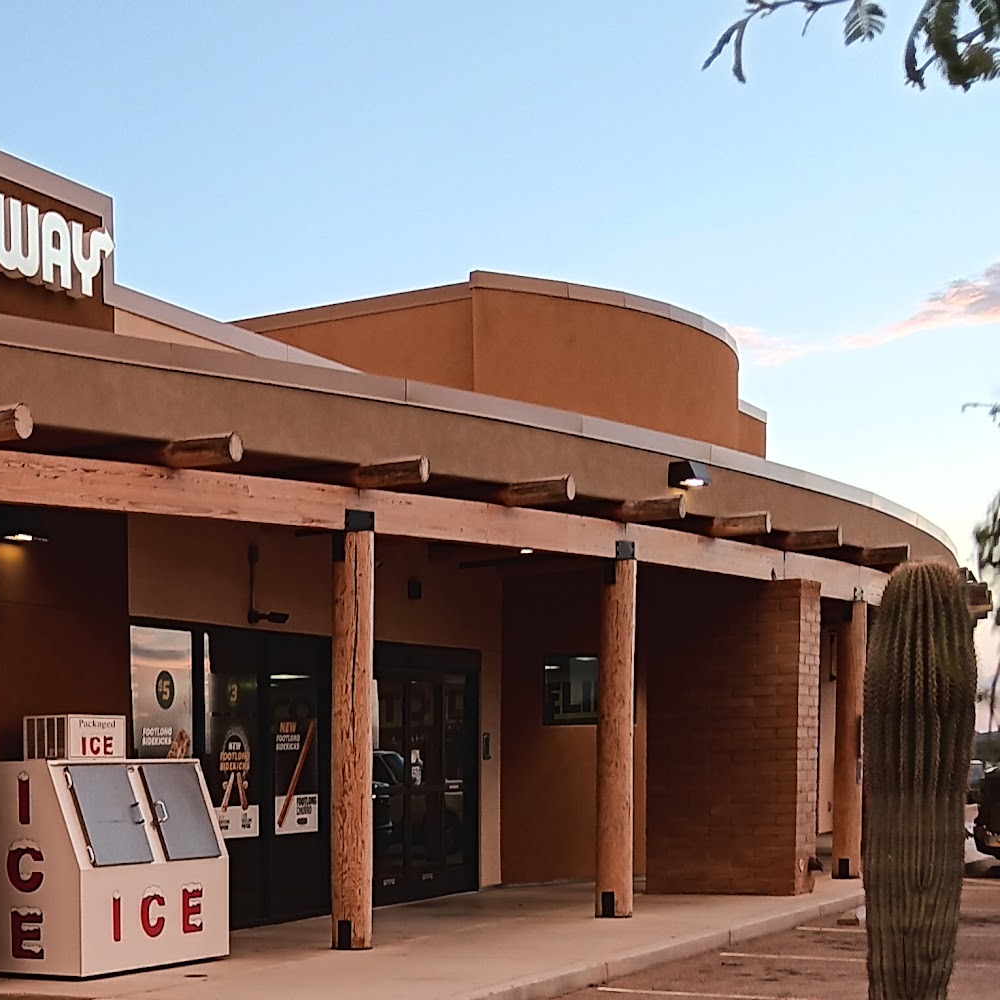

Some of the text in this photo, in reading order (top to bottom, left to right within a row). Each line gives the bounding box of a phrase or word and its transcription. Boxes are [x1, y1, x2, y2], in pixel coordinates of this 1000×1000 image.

[78, 719, 116, 729] Packaged
[279, 721, 297, 733] NEW
[142, 726, 173, 737] FOOTLONG
[275, 733, 301, 742] FOOTLONG
[81, 736, 114, 756] ICE
[228, 741, 242, 750] NEW
[6, 770, 45, 960] ICE
[112, 881, 204, 943] ICE
